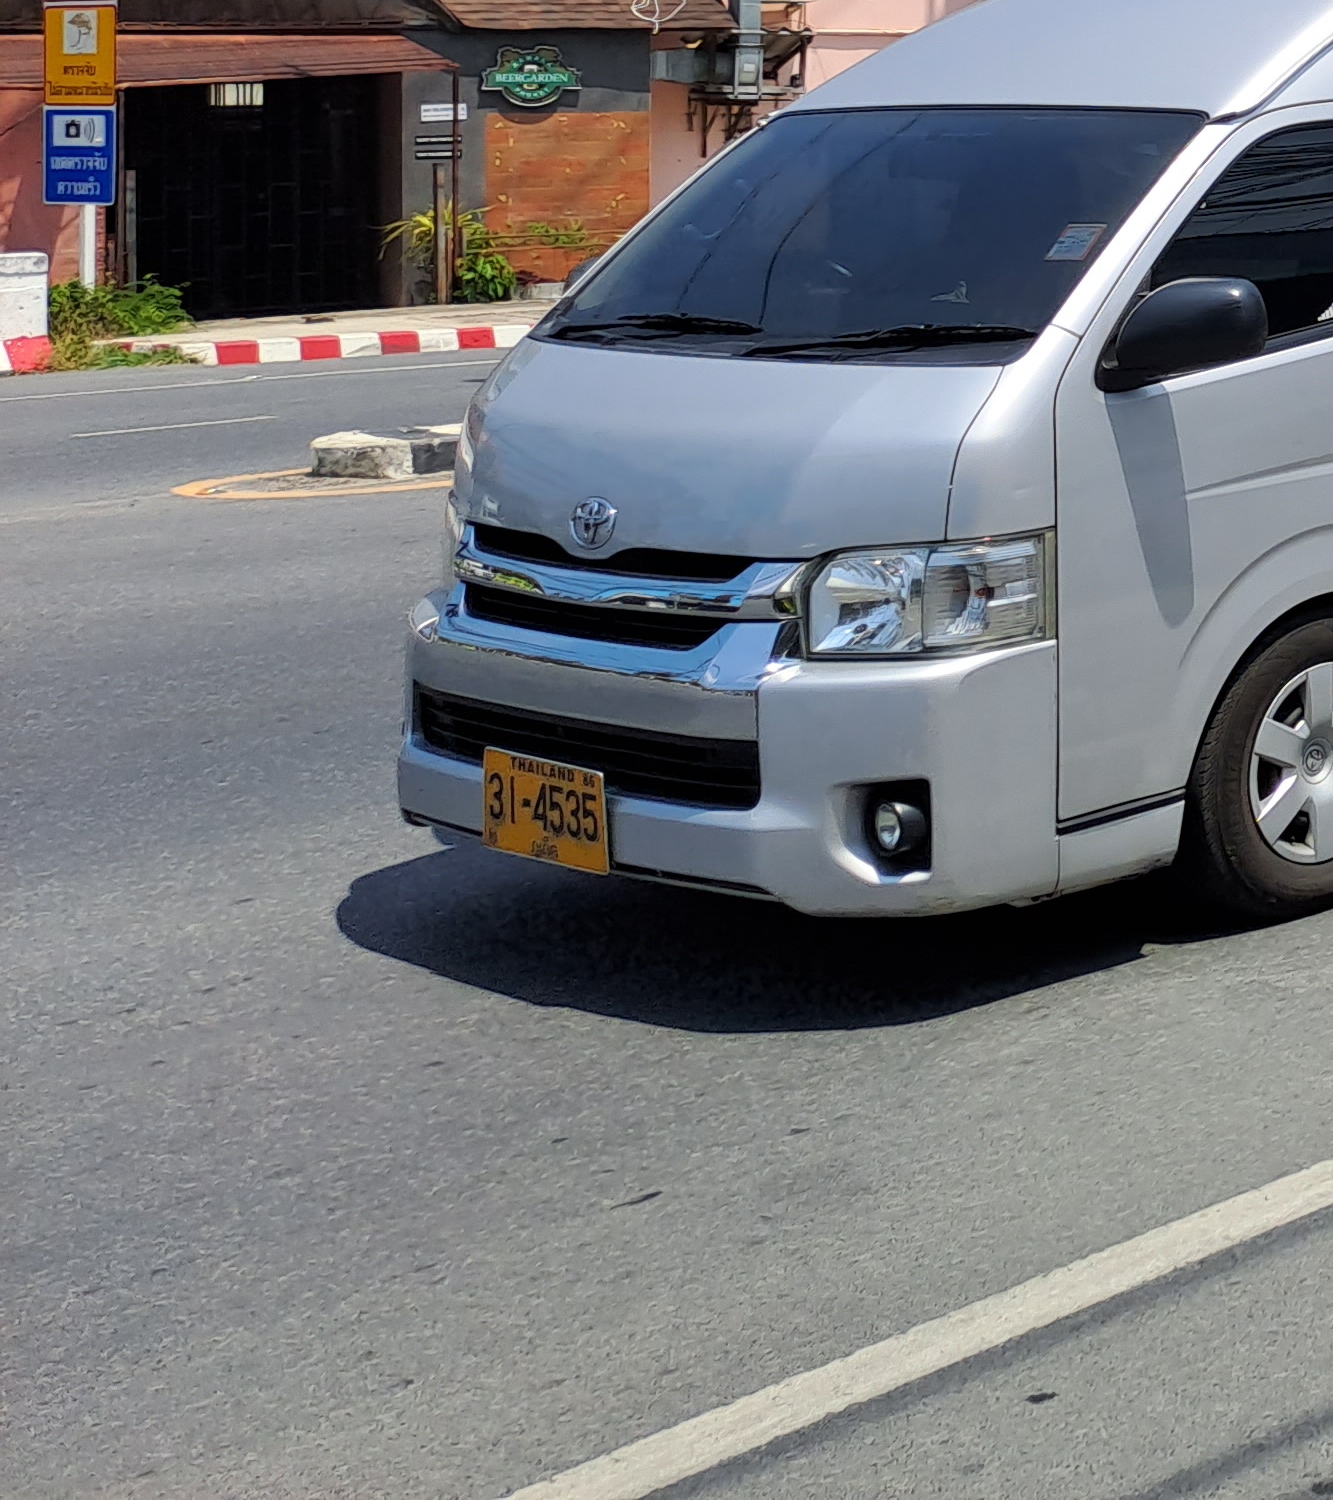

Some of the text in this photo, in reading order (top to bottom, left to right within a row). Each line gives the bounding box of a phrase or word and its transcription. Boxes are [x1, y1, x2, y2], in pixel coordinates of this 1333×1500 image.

[495, 73, 569, 83] BEERGARDEN
[510, 756, 575, 783] THAILAND
[488, 771, 600, 843] 31-4535
